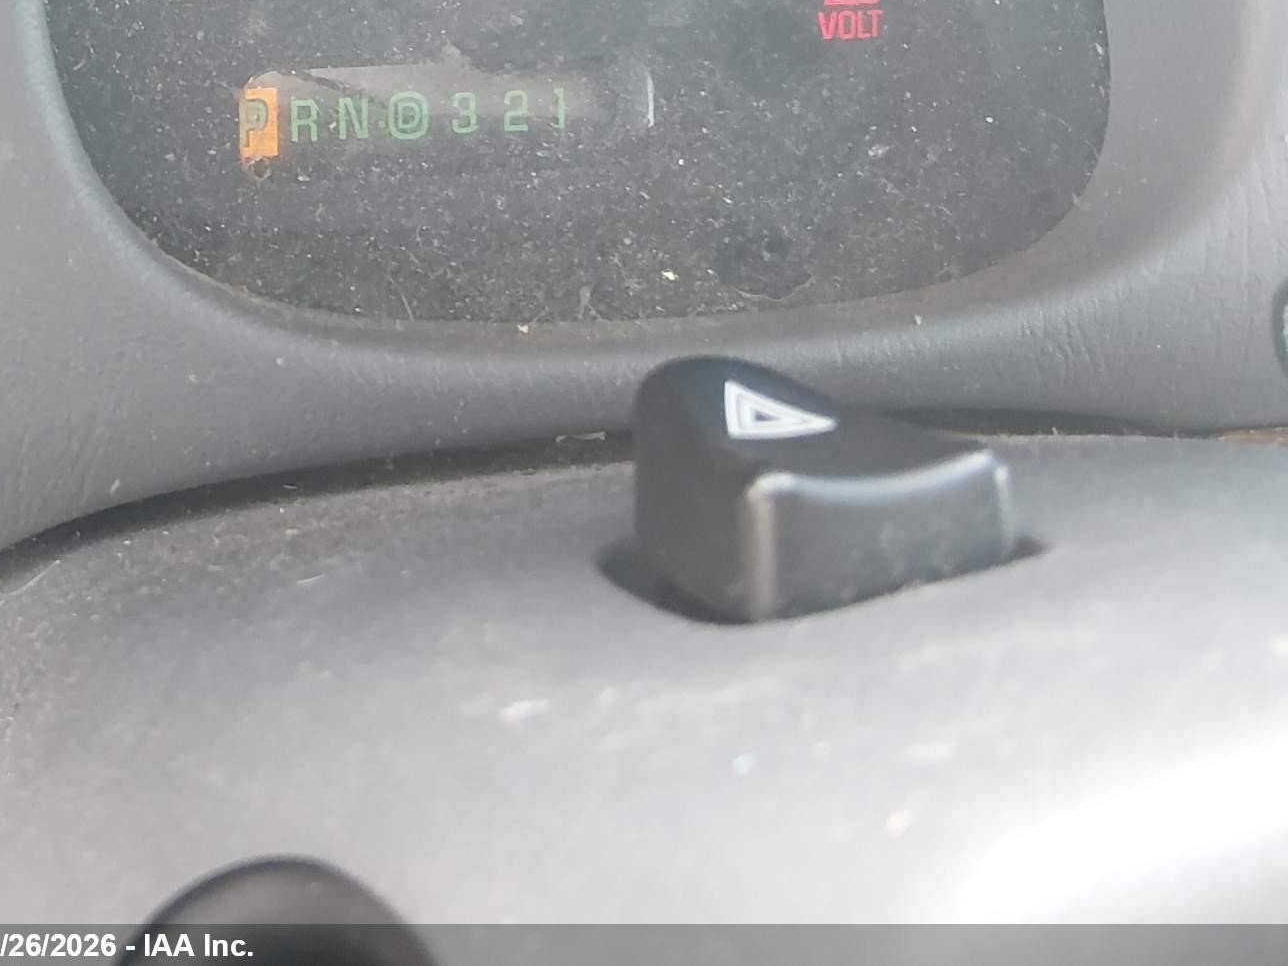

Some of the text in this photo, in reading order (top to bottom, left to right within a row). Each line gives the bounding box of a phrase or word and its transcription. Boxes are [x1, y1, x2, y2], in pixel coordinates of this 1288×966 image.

[818, 10, 883, 40] VOLT
[290, 96, 319, 141] R
[338, 97, 369, 139] N
[452, 91, 479, 134] 3
[504, 90, 529, 132] 2
[553, 87, 567, 130] 1
